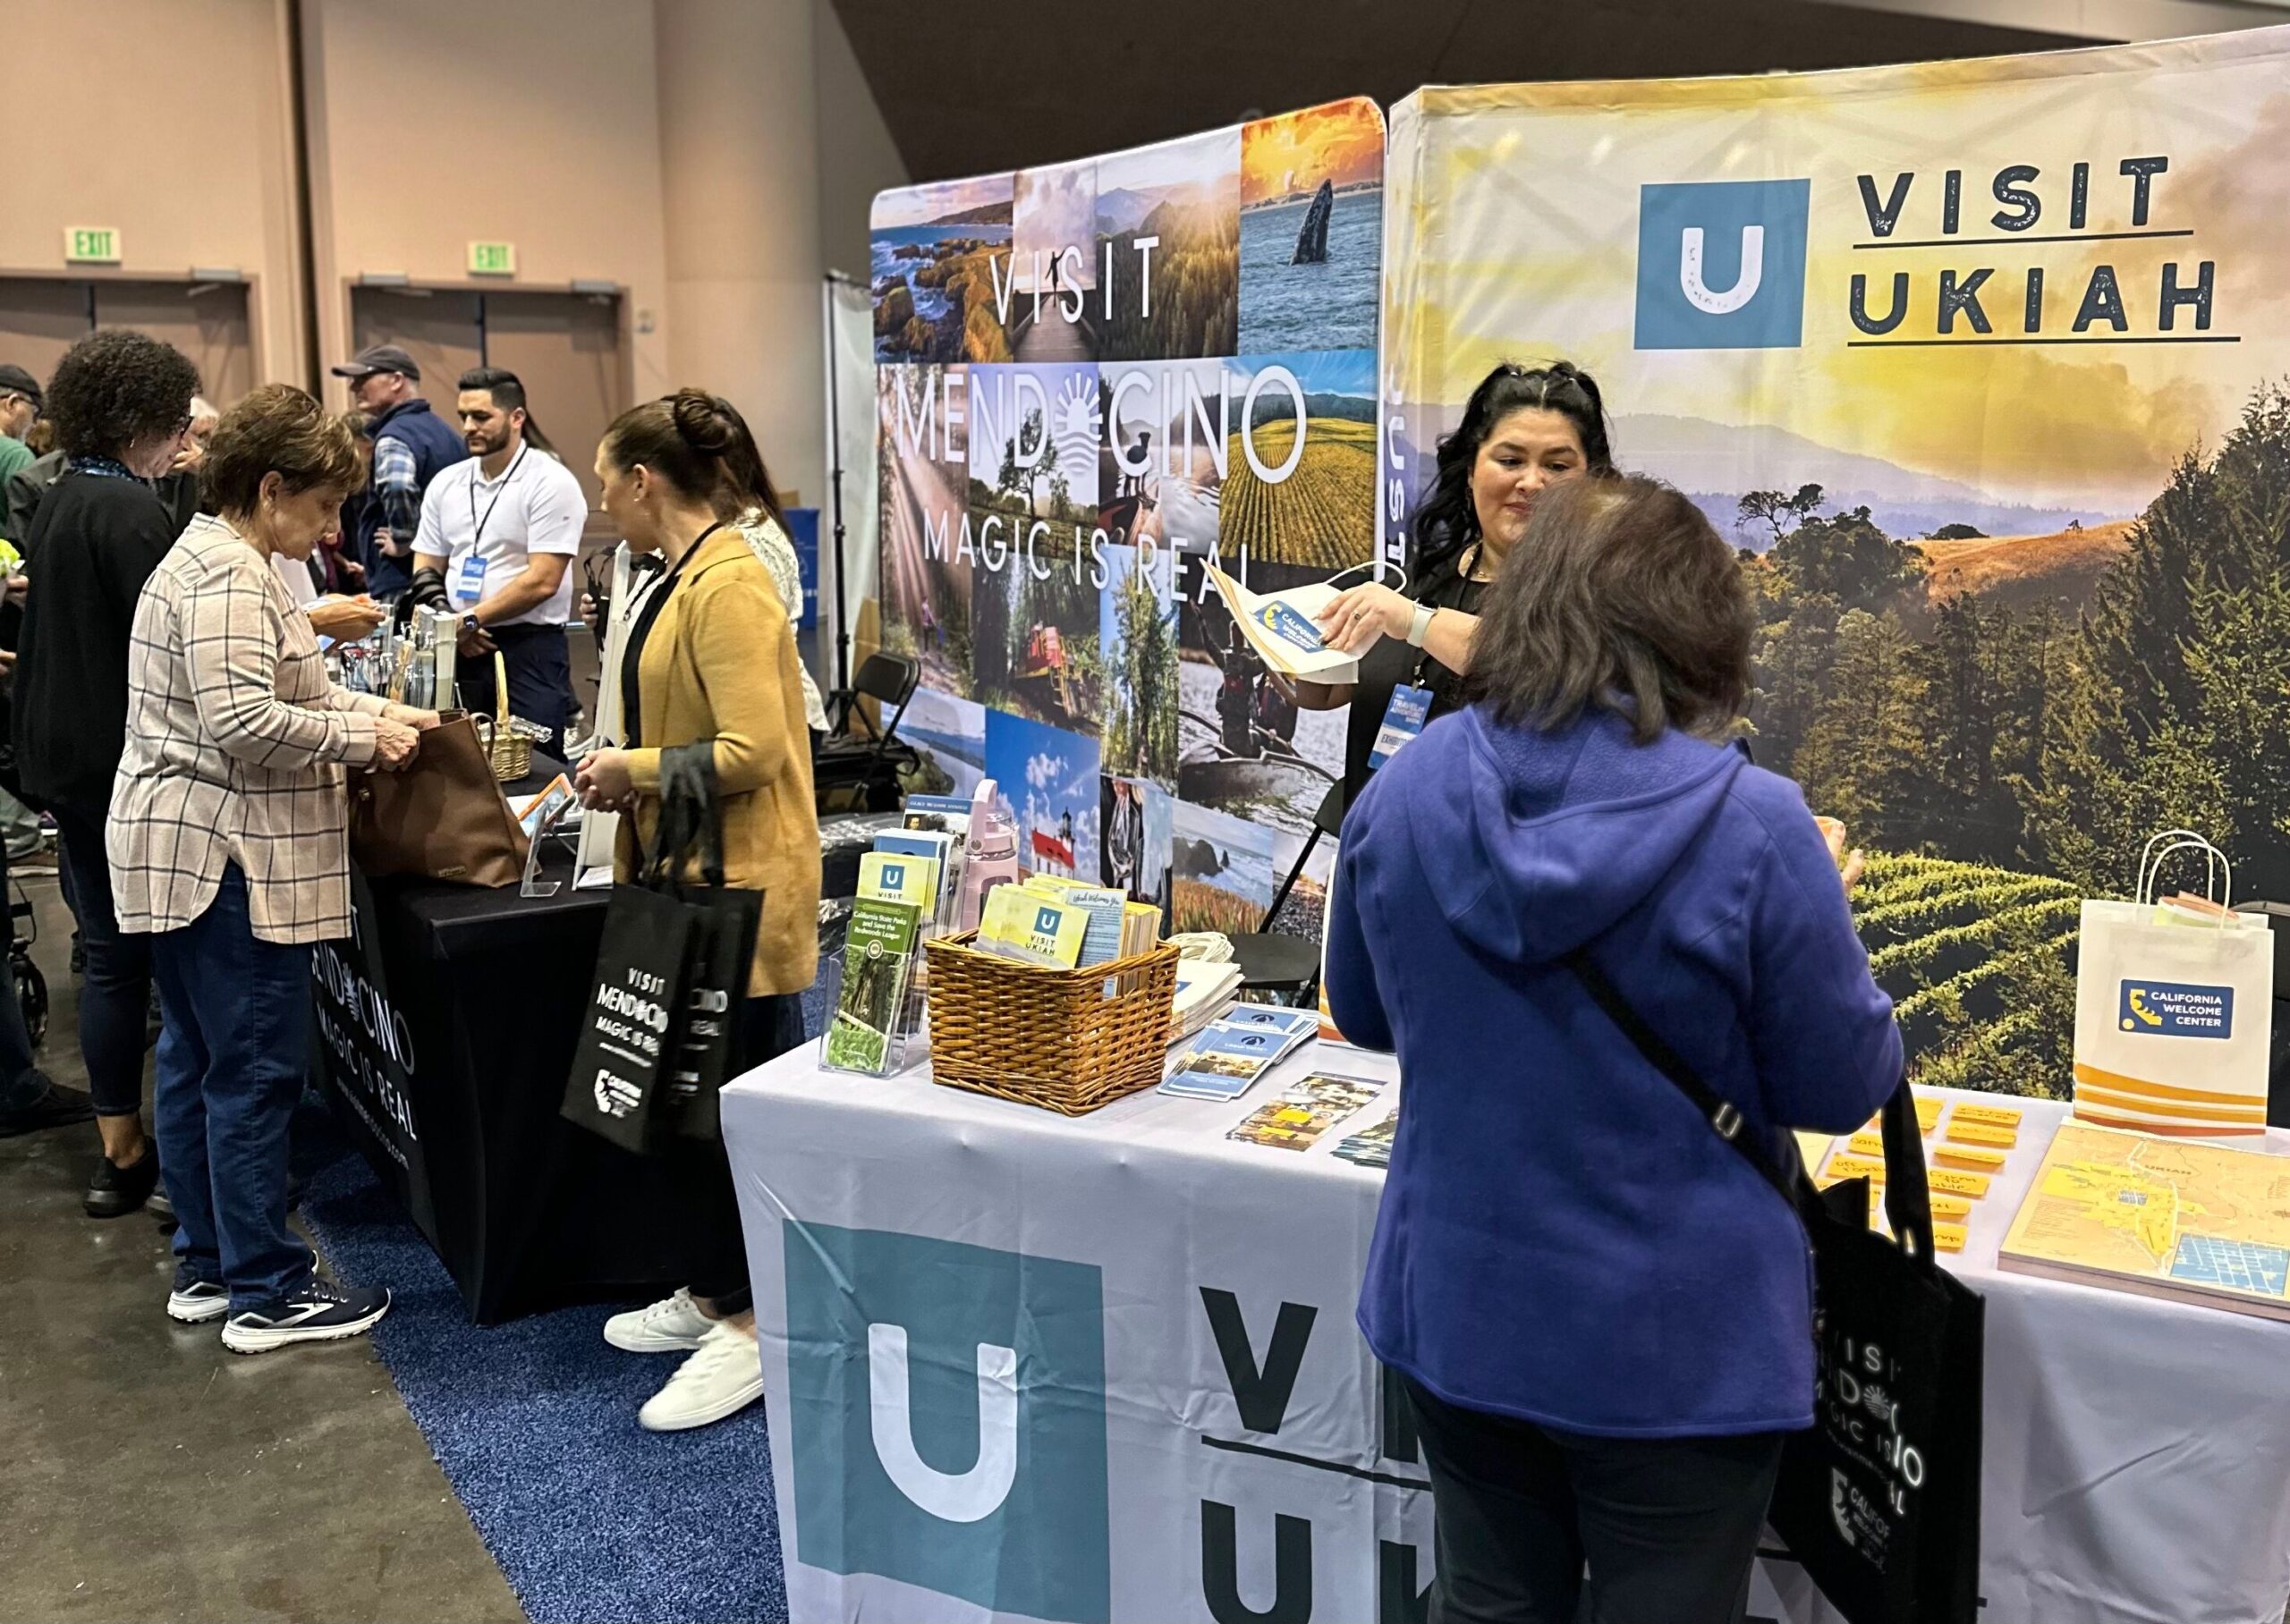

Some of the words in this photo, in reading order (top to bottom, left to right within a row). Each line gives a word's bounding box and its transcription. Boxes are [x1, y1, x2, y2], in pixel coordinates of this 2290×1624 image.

[1858, 156, 2168, 236] VISIT
[75, 230, 112, 257] EXIT
[476, 243, 507, 268] EXIT
[988, 236, 1159, 326] VISIT
[1681, 225, 1764, 314] U
[1849, 261, 2214, 334] UKIAH
[924, 509, 1051, 579] MAGIC
[1075, 528, 1109, 589] IS
[886, 870, 899, 885] U
[878, 892, 903, 900] VISIT
[1041, 914, 1056, 929] U
[1026, 942, 1056, 956] UKIAH
[1030, 934, 1056, 946] VISIT
[628, 968, 665, 995] VISIT
[2150, 992, 2223, 1004] CALIFORNIA
[2163, 1003, 2223, 1016] WELCOME
[596, 1016, 632, 1042] MAGIC
[2176, 1016, 2222, 1028] CENTER
[317, 1001, 358, 1075] MAGIC
[360, 1051, 375, 1095] IS
[377, 1070, 417, 1141] REAL
[868, 1323, 1018, 1523] U
